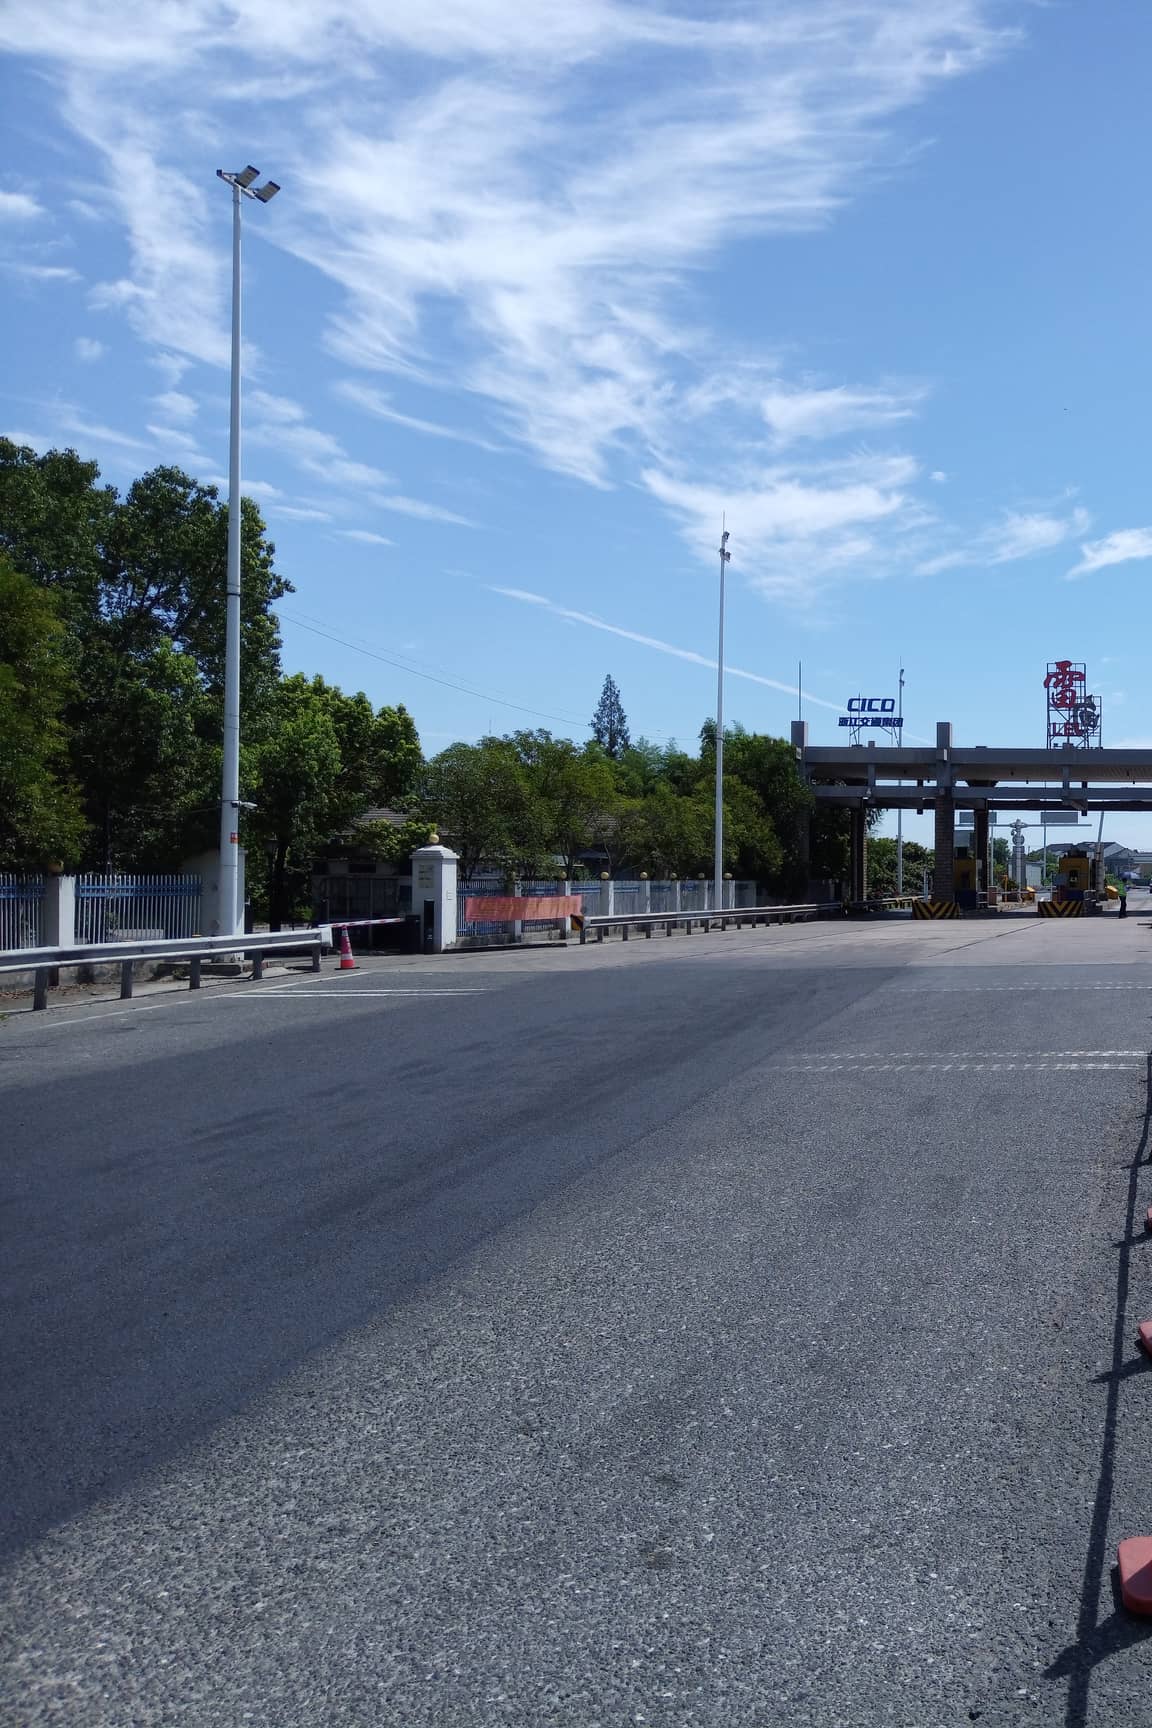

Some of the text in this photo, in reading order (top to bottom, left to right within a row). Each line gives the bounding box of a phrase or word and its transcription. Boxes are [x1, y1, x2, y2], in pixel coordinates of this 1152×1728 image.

[1043, 660, 1085, 708] 雷
[847, 698, 895, 712] CICO
[839, 717, 903, 727] 浙江交通集团
